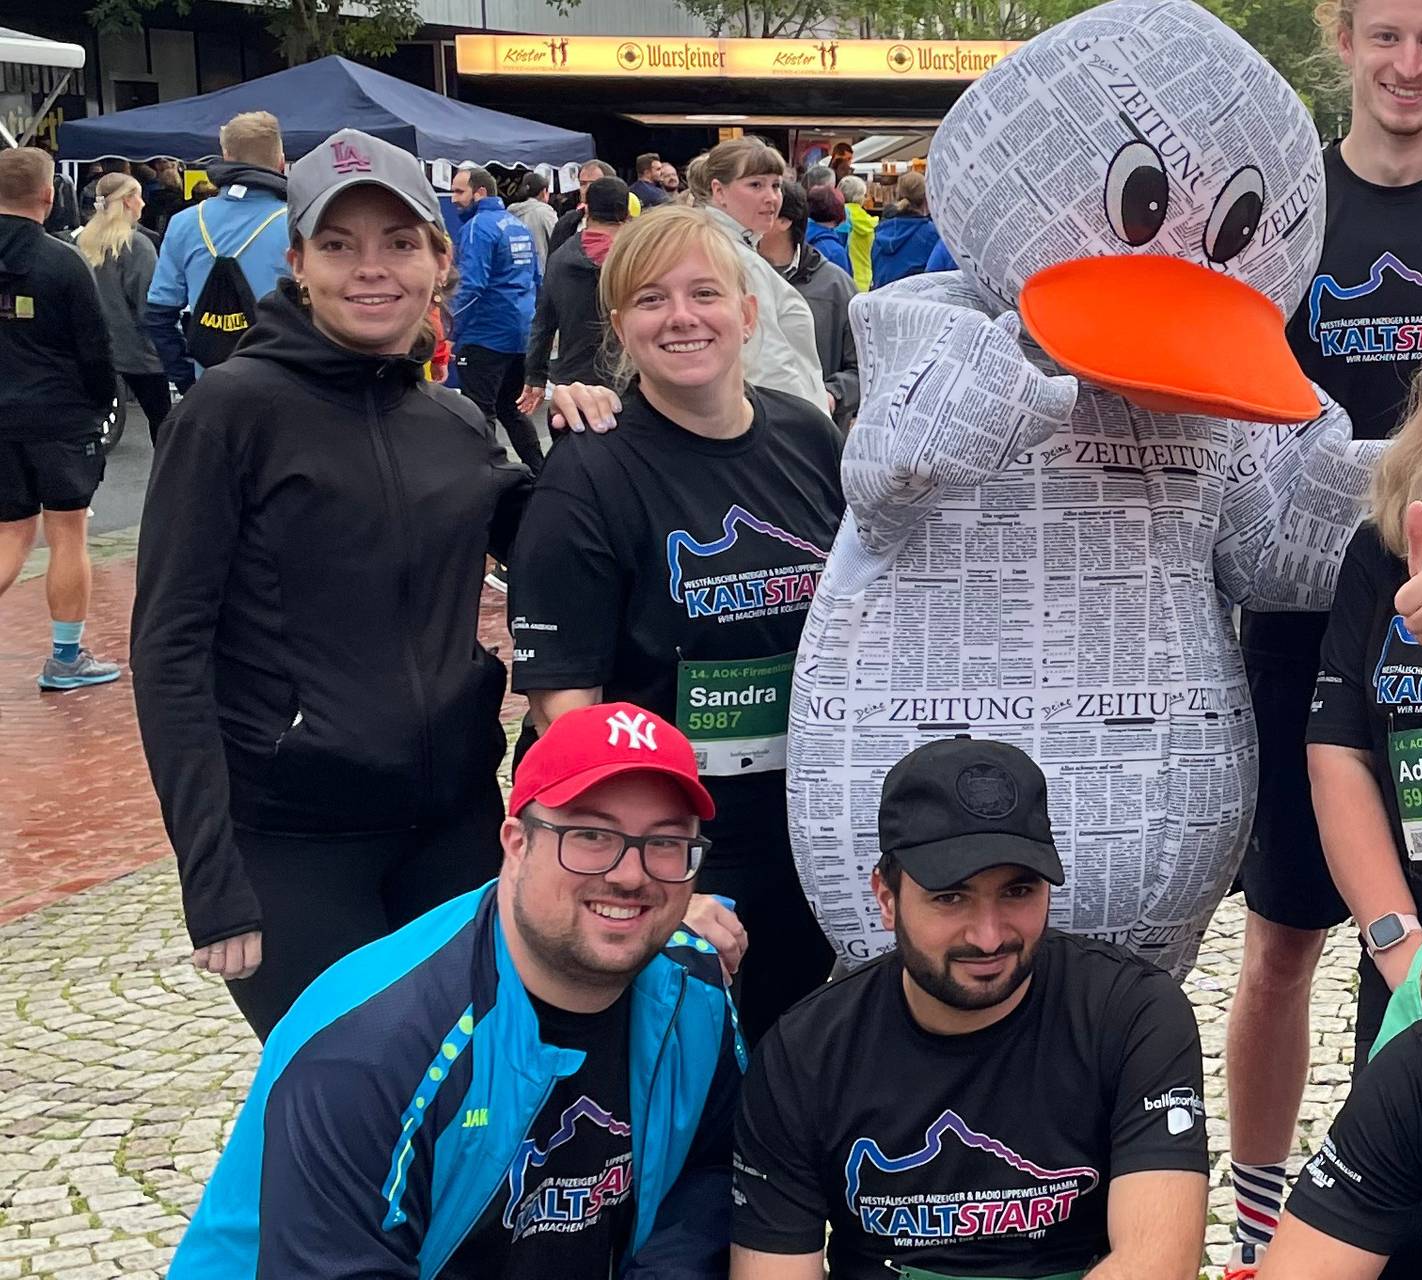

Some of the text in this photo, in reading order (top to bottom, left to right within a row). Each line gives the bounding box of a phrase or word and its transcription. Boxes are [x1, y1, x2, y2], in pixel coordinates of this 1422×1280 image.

[503, 48, 547, 64] Köster
[647, 44, 726, 71] Warsteiner
[917, 46, 998, 74] Warsteiner
[330, 141, 372, 174] LA
[1346, 354, 1362, 363] WIR
[1362, 353, 1395, 362] MACHEN
[683, 574, 739, 590] WESTFÄLISCHER
[685, 572, 823, 619] KALTSTA
[718, 615, 735, 624] WIR
[735, 608, 766, 621] MACHEN
[689, 685, 777, 707] Sandra
[889, 696, 1035, 722] ZEITUNG
[1397, 705, 1413, 714] WIR
[688, 711, 742, 730] 5987
[606, 710, 658, 752] NY
[555, 1176, 597, 1187] ANZEIGER
[860, 1179, 1078, 1206] WESTFÄLISCHER ANZEIGER & RADIO LIPPEWELLE HAMM
[860, 1190, 1079, 1238] KALTSTART
[538, 1221, 584, 1233] MACHEN
[894, 1237, 913, 1247] WIR
[914, 1237, 957, 1247] MACHEN
